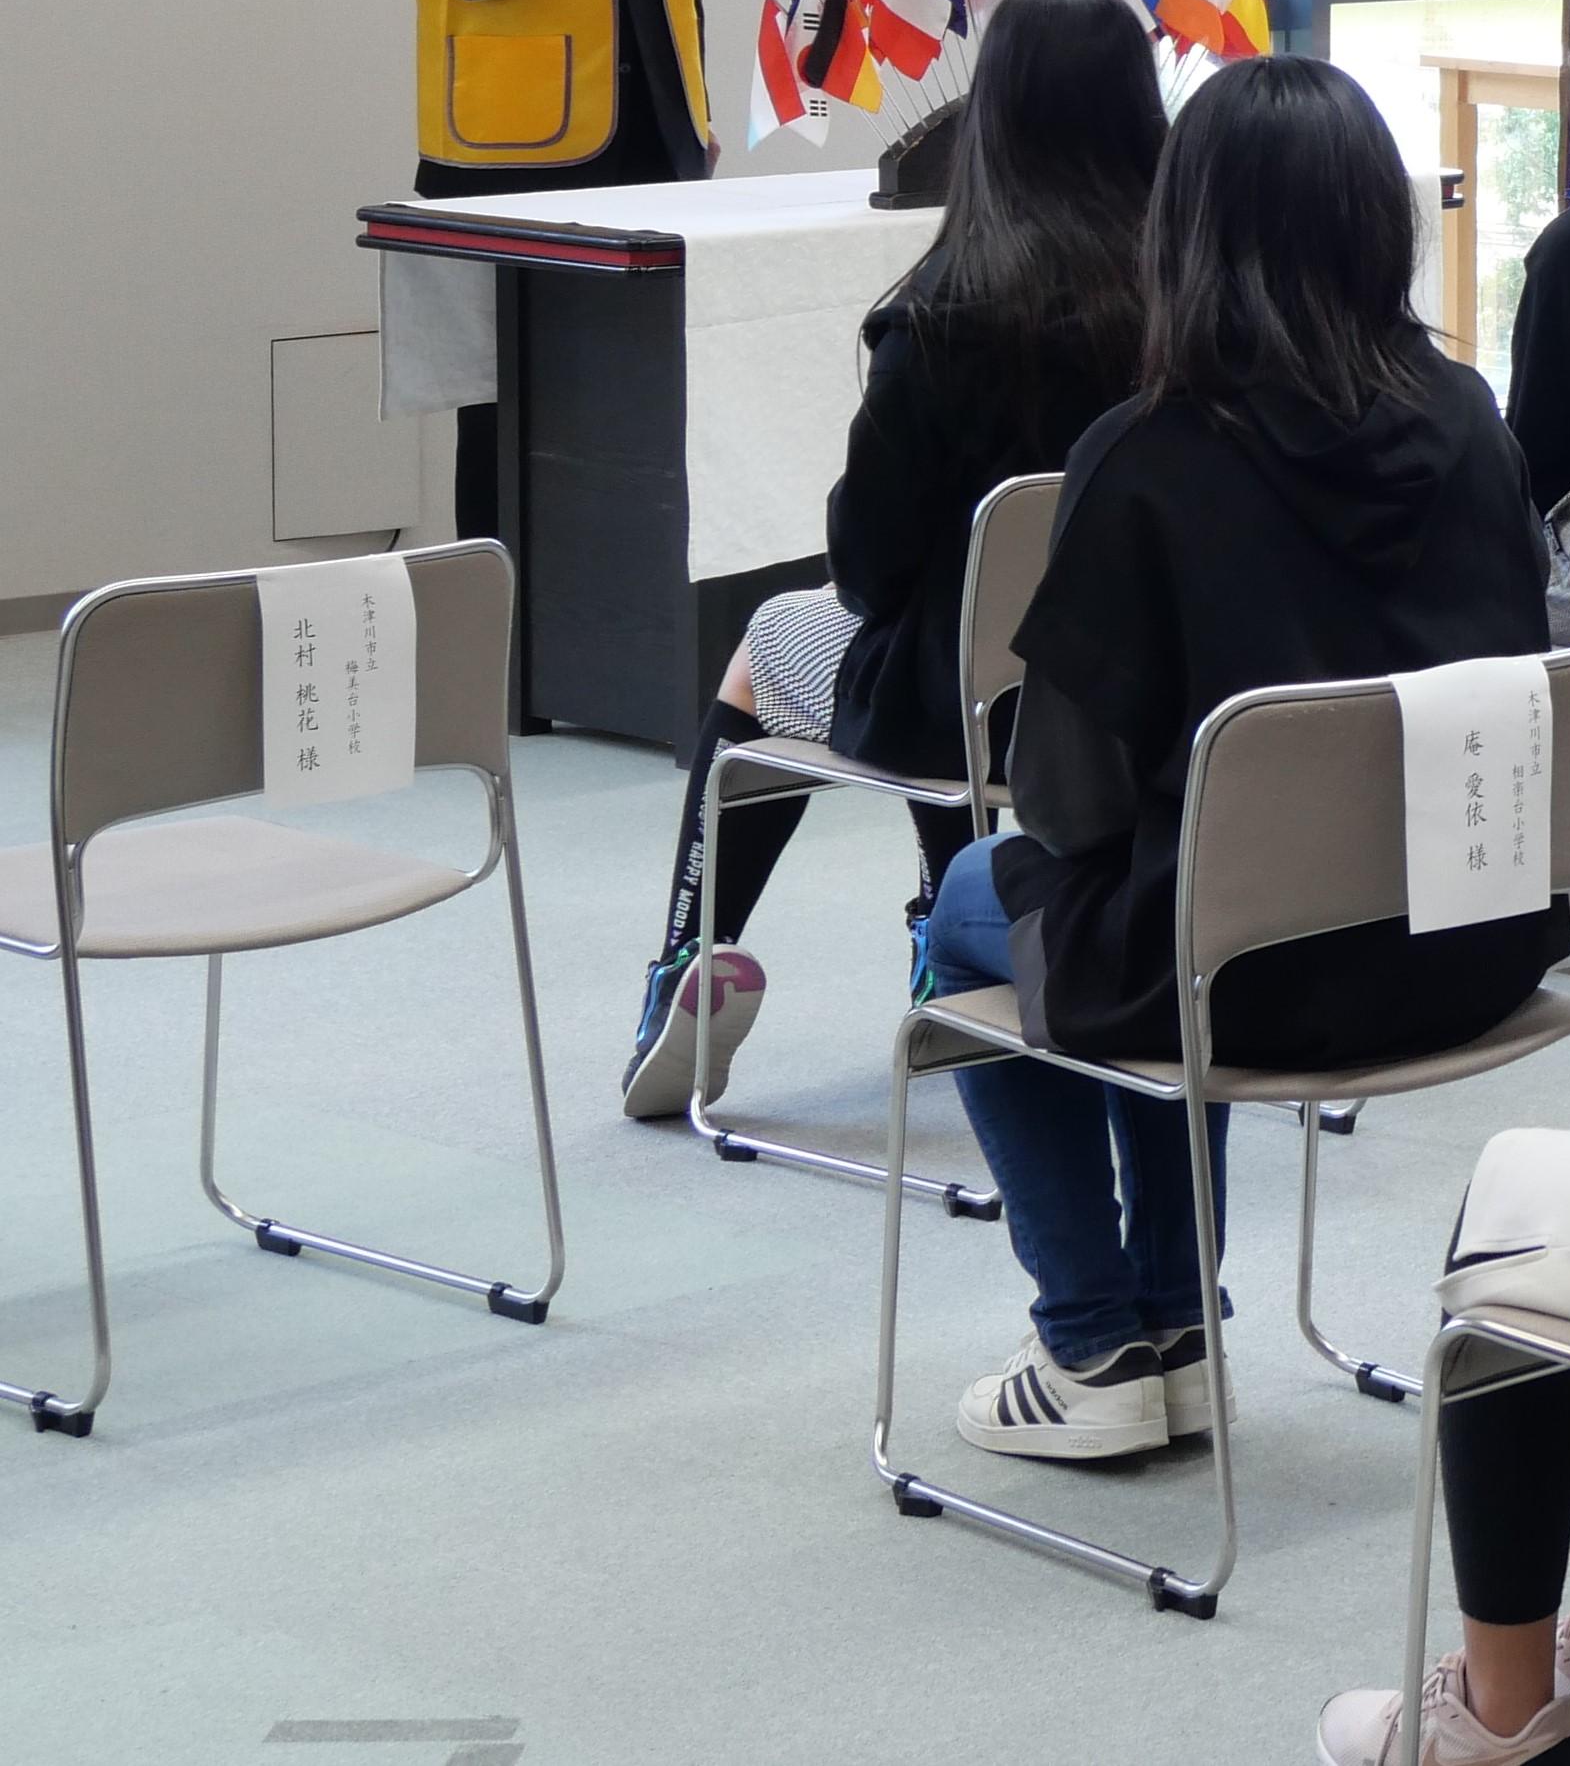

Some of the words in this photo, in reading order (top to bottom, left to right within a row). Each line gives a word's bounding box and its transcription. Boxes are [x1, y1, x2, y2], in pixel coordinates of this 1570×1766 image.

[293, 618, 316, 668] 北村
[362, 593, 379, 672] 木津川市立
[296, 683, 320, 733] 桃花
[297, 745, 320, 771] 様
[1528, 690, 1542, 777] 木津川市立
[1465, 772, 1488, 827] 愛依
[1512, 764, 1525, 867] 相楽台小学校
[1466, 845, 1488, 871] 様
[673, 888, 694, 930] MOOD
